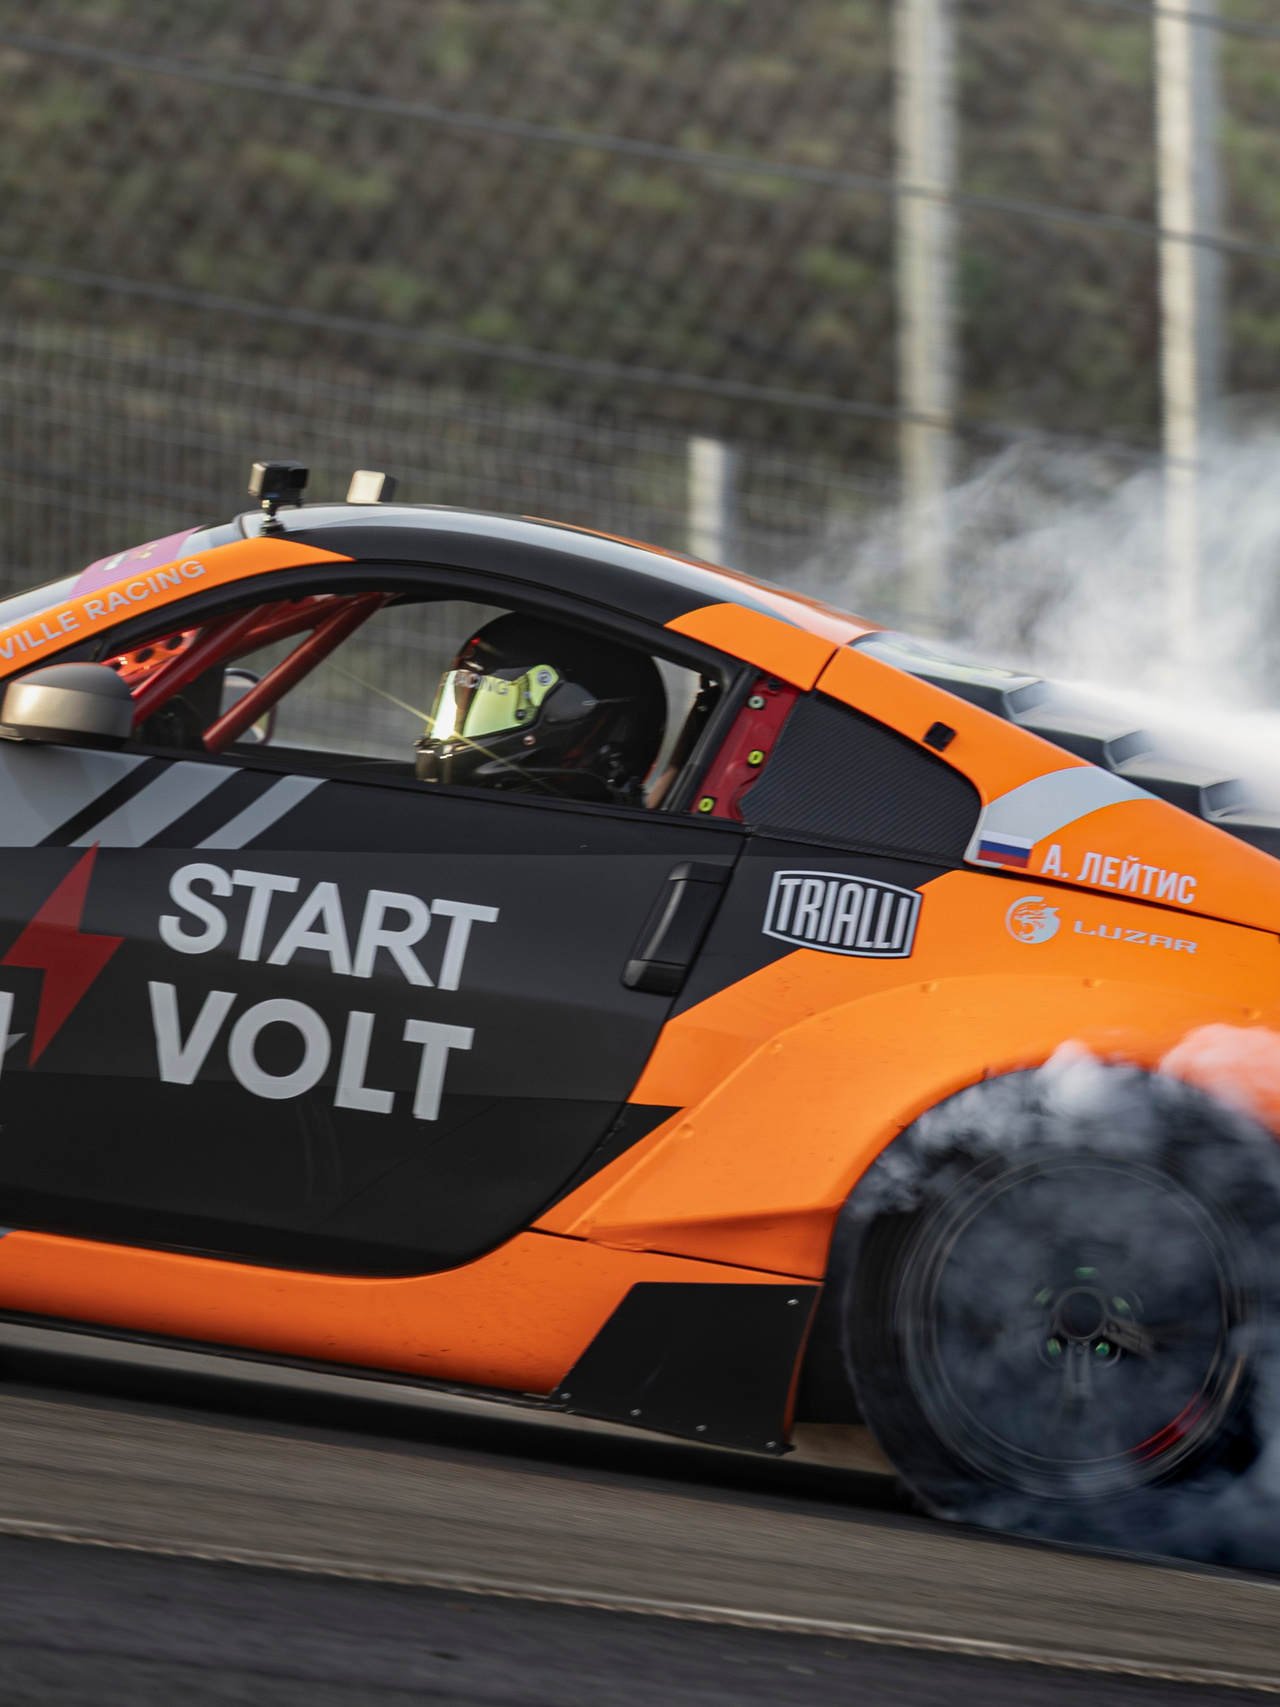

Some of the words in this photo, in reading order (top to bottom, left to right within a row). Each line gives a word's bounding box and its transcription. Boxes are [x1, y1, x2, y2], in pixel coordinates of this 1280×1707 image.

[0, 610, 81, 659] VILLE
[83, 560, 207, 620] RACING
[775, 878, 912, 949] TRIALLI
[1041, 844, 1070, 878] А.
[1076, 852, 1198, 904] ЛЕЙТИС
[158, 862, 500, 991] START
[1074, 920, 1199, 954] LUZAR
[148, 980, 475, 1122] VOLT
